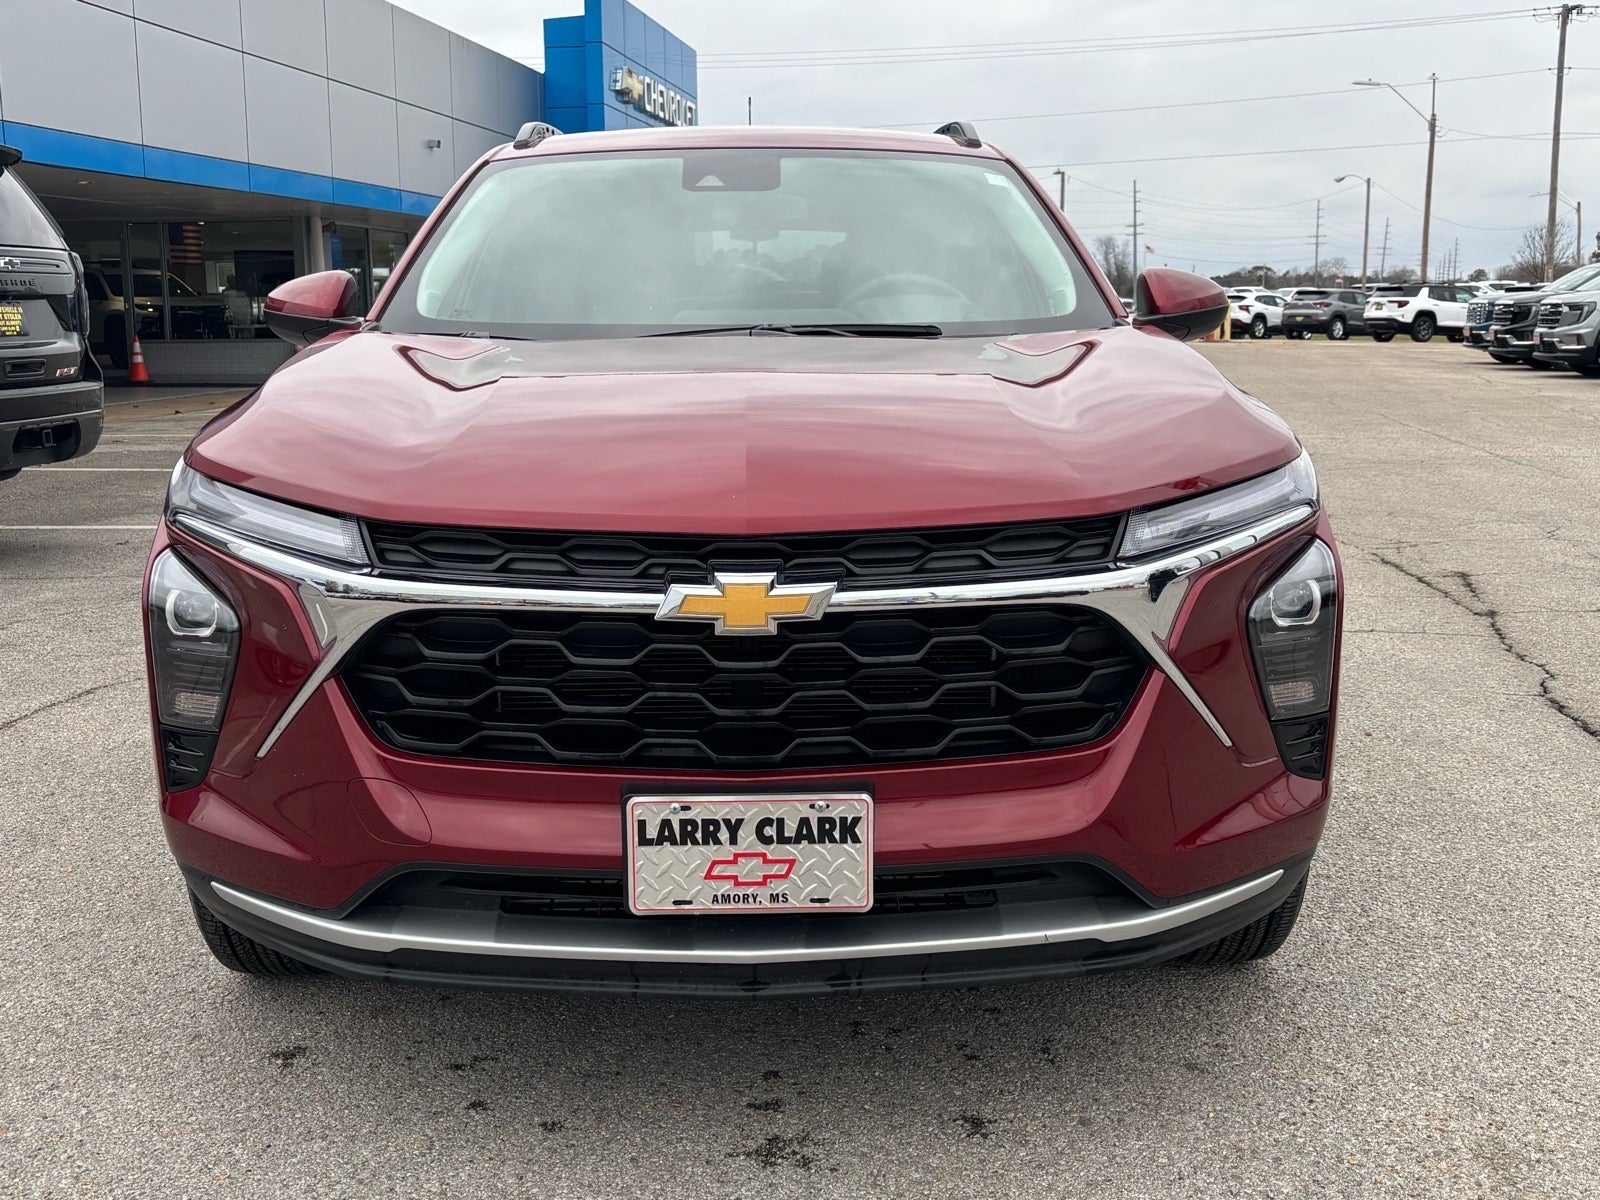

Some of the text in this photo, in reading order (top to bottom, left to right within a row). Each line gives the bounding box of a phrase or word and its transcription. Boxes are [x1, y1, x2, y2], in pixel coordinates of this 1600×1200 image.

[644, 76, 697, 126] CHEVROLET
[637, 816, 862, 846] LARRY CLARK
[711, 892, 789, 906] AMORY, MS
